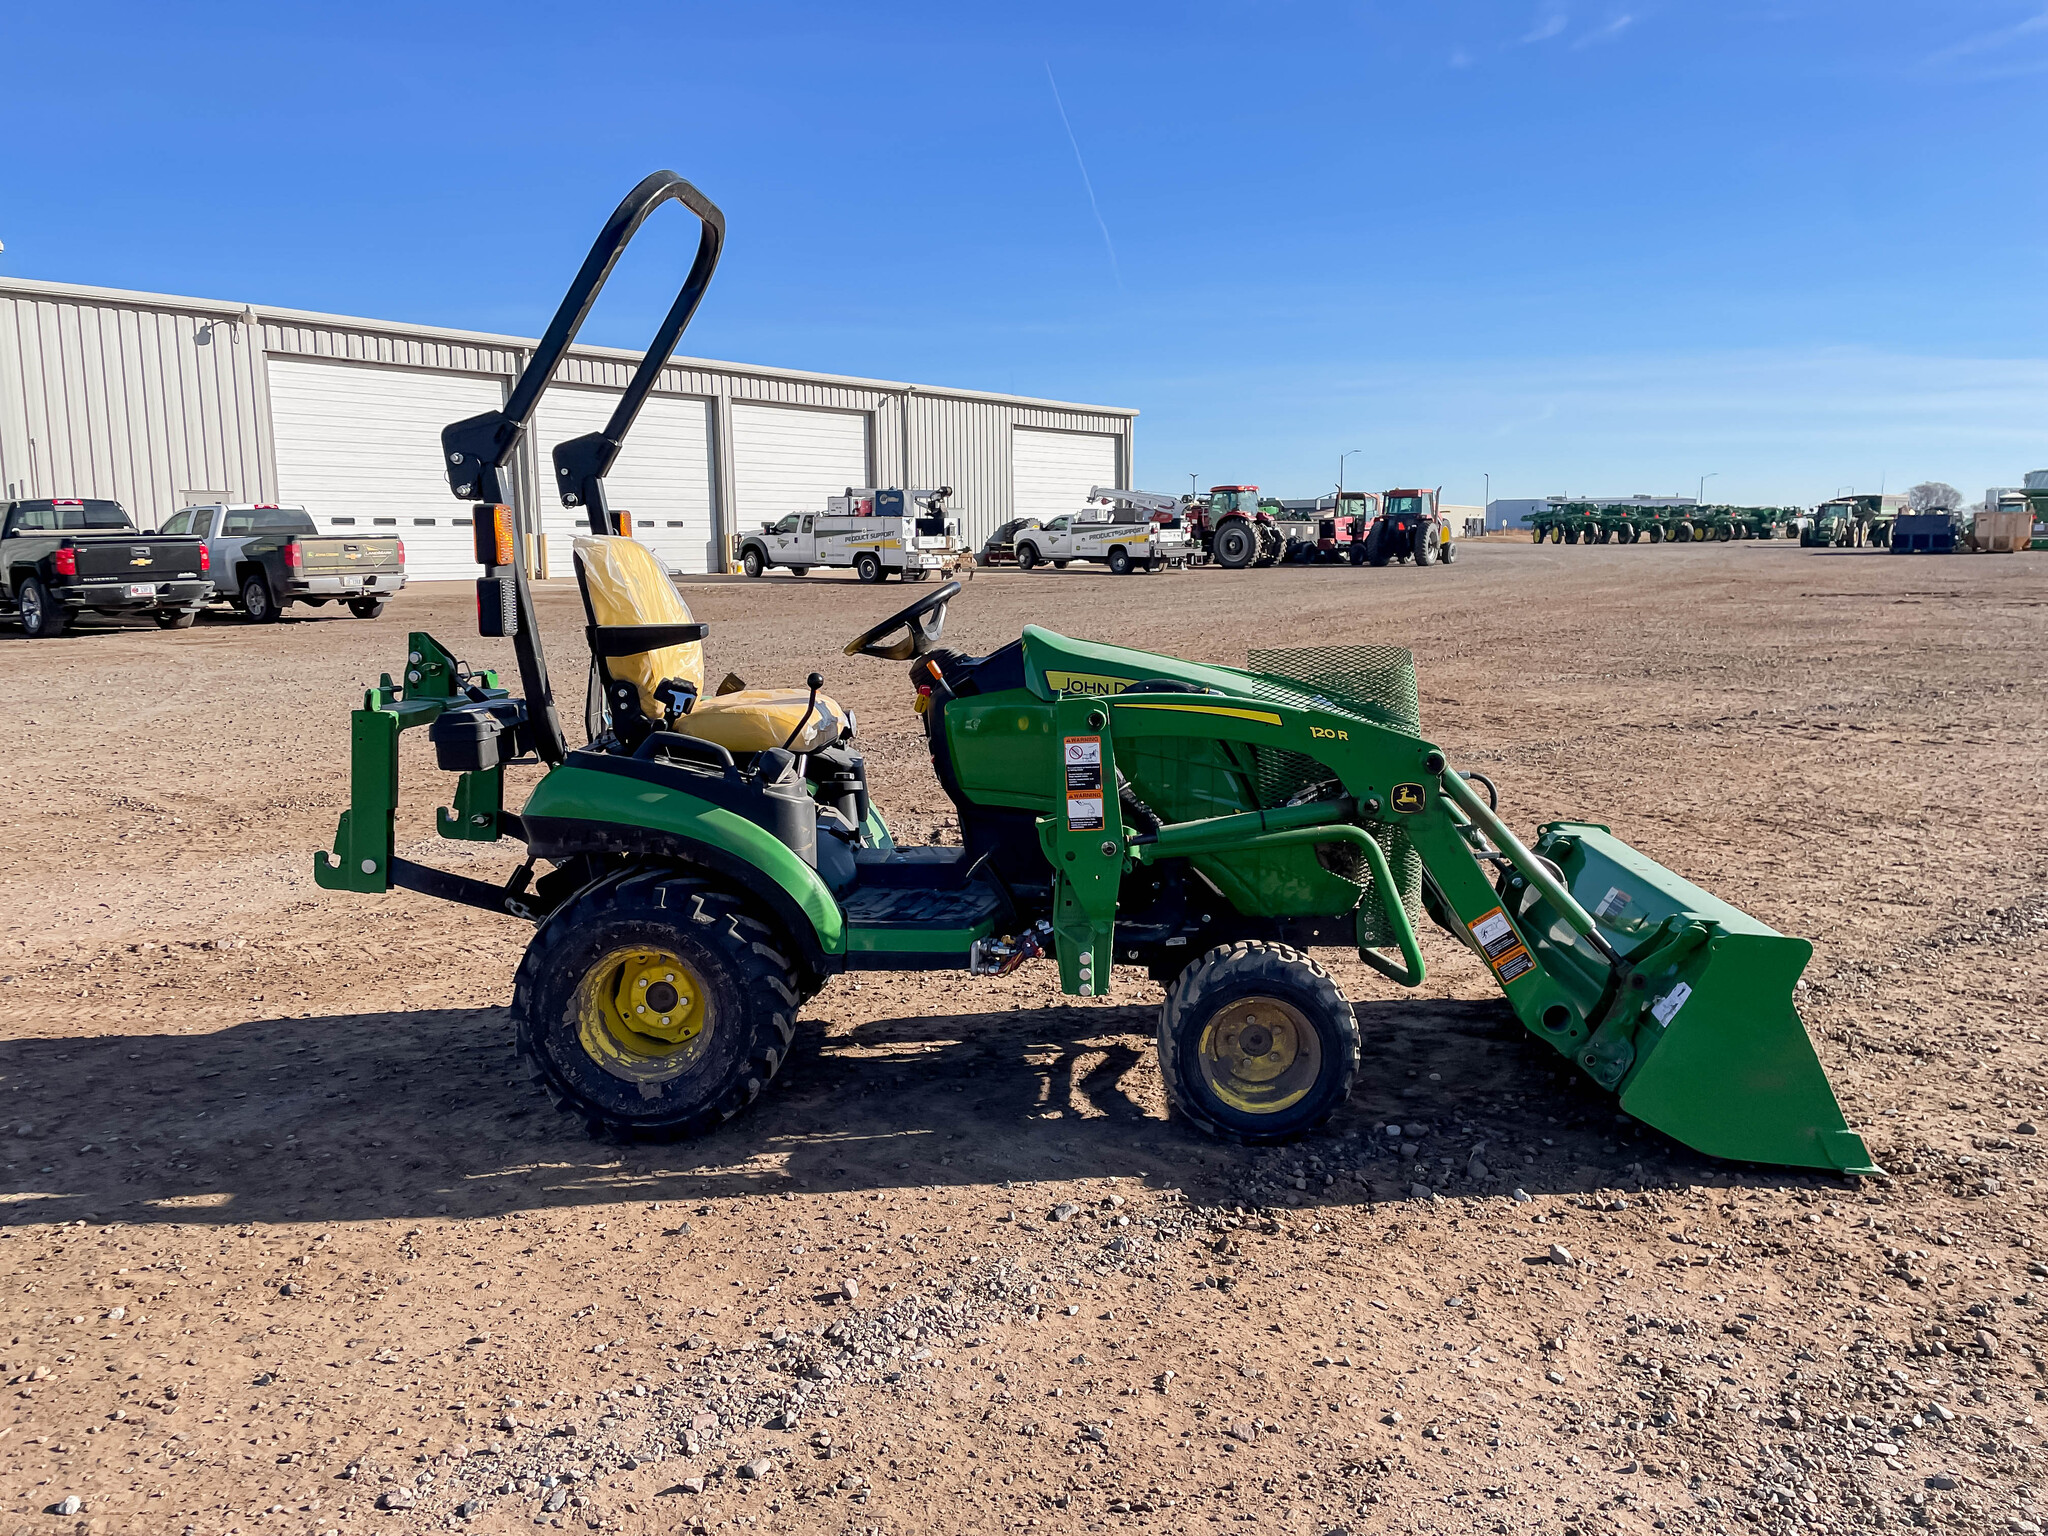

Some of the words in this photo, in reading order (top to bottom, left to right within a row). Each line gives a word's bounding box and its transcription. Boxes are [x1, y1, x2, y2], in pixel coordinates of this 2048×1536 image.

[844, 533, 869, 543] PRODUCT
[870, 530, 895, 539] SUPPORT
[1088, 531, 1115, 541] PRODUCT
[1118, 526, 1145, 536] SUPPORT
[1062, 677, 1110, 694] JOHN
[1309, 726, 1336, 739] 120
[1337, 730, 1349, 741] R
